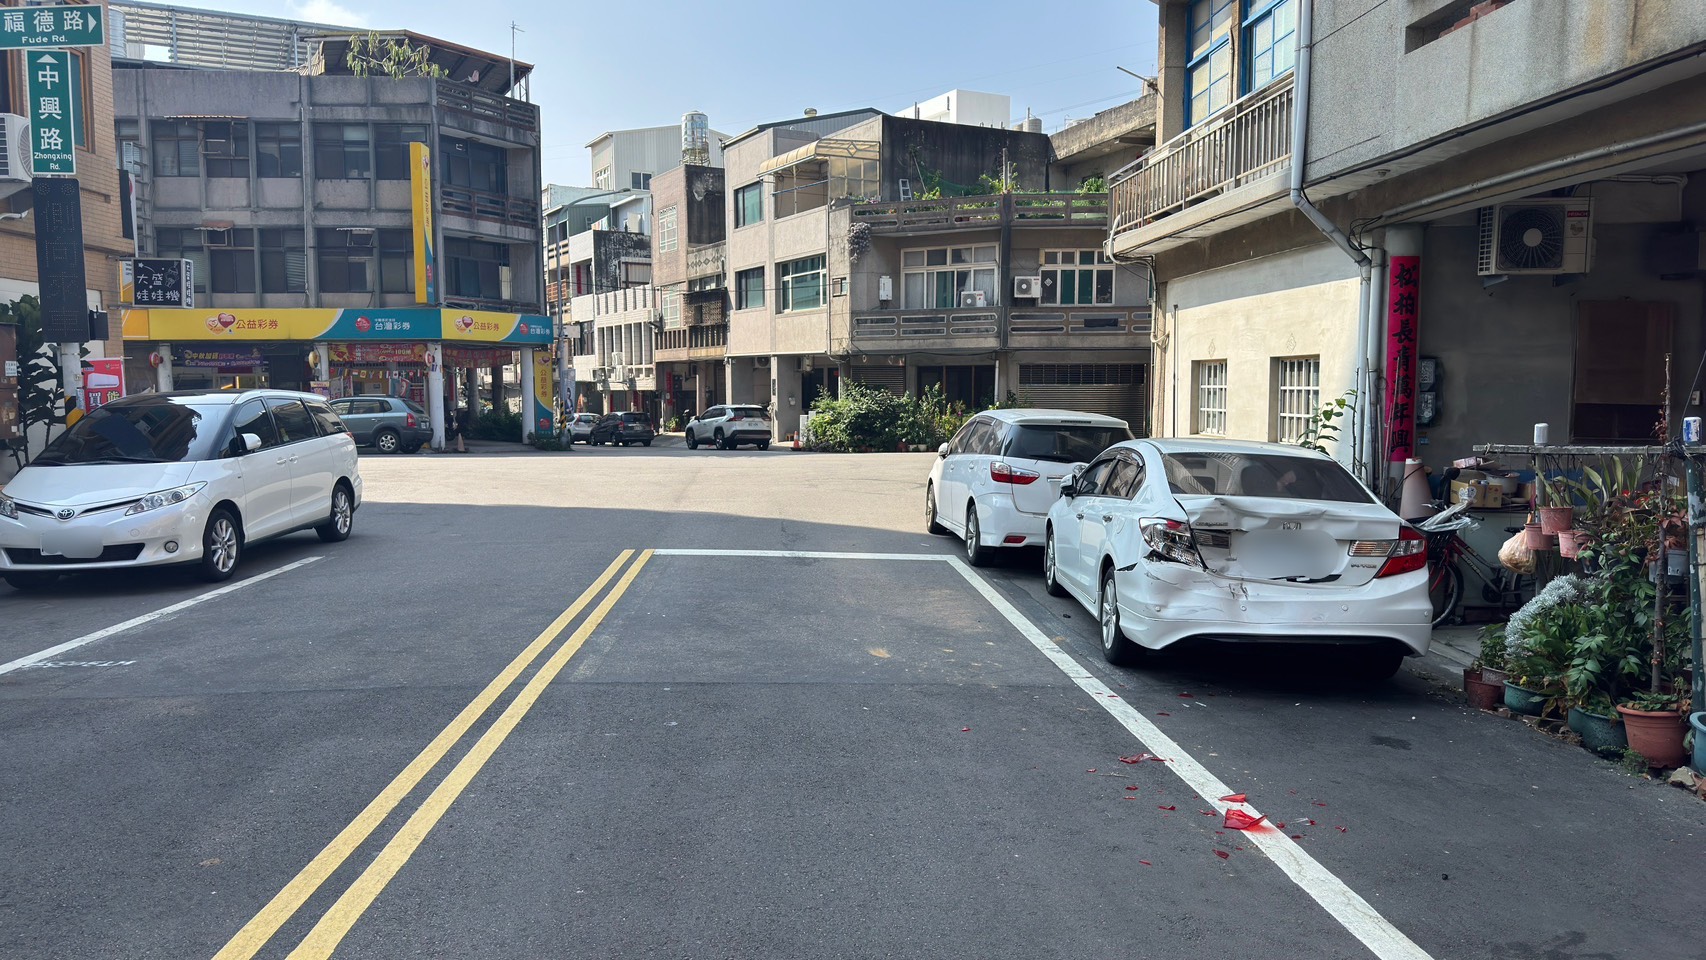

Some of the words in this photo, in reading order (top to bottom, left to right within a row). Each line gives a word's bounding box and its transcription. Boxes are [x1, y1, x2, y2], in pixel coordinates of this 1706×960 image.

[3, 10, 83, 32] 福德路
[21, 36, 48, 44] Fude
[52, 35, 68, 43] Rd.
[38, 65, 63, 150] 中興路
[34, 152, 72, 161] Zhongxing
[136, 273, 164, 285] 大盛
[136, 289, 180, 302] 娃娃機
[236, 319, 279, 329] 公益彩券
[374, 322, 411, 330] 台灣彩券
[474, 321, 500, 331] 公益彩券
